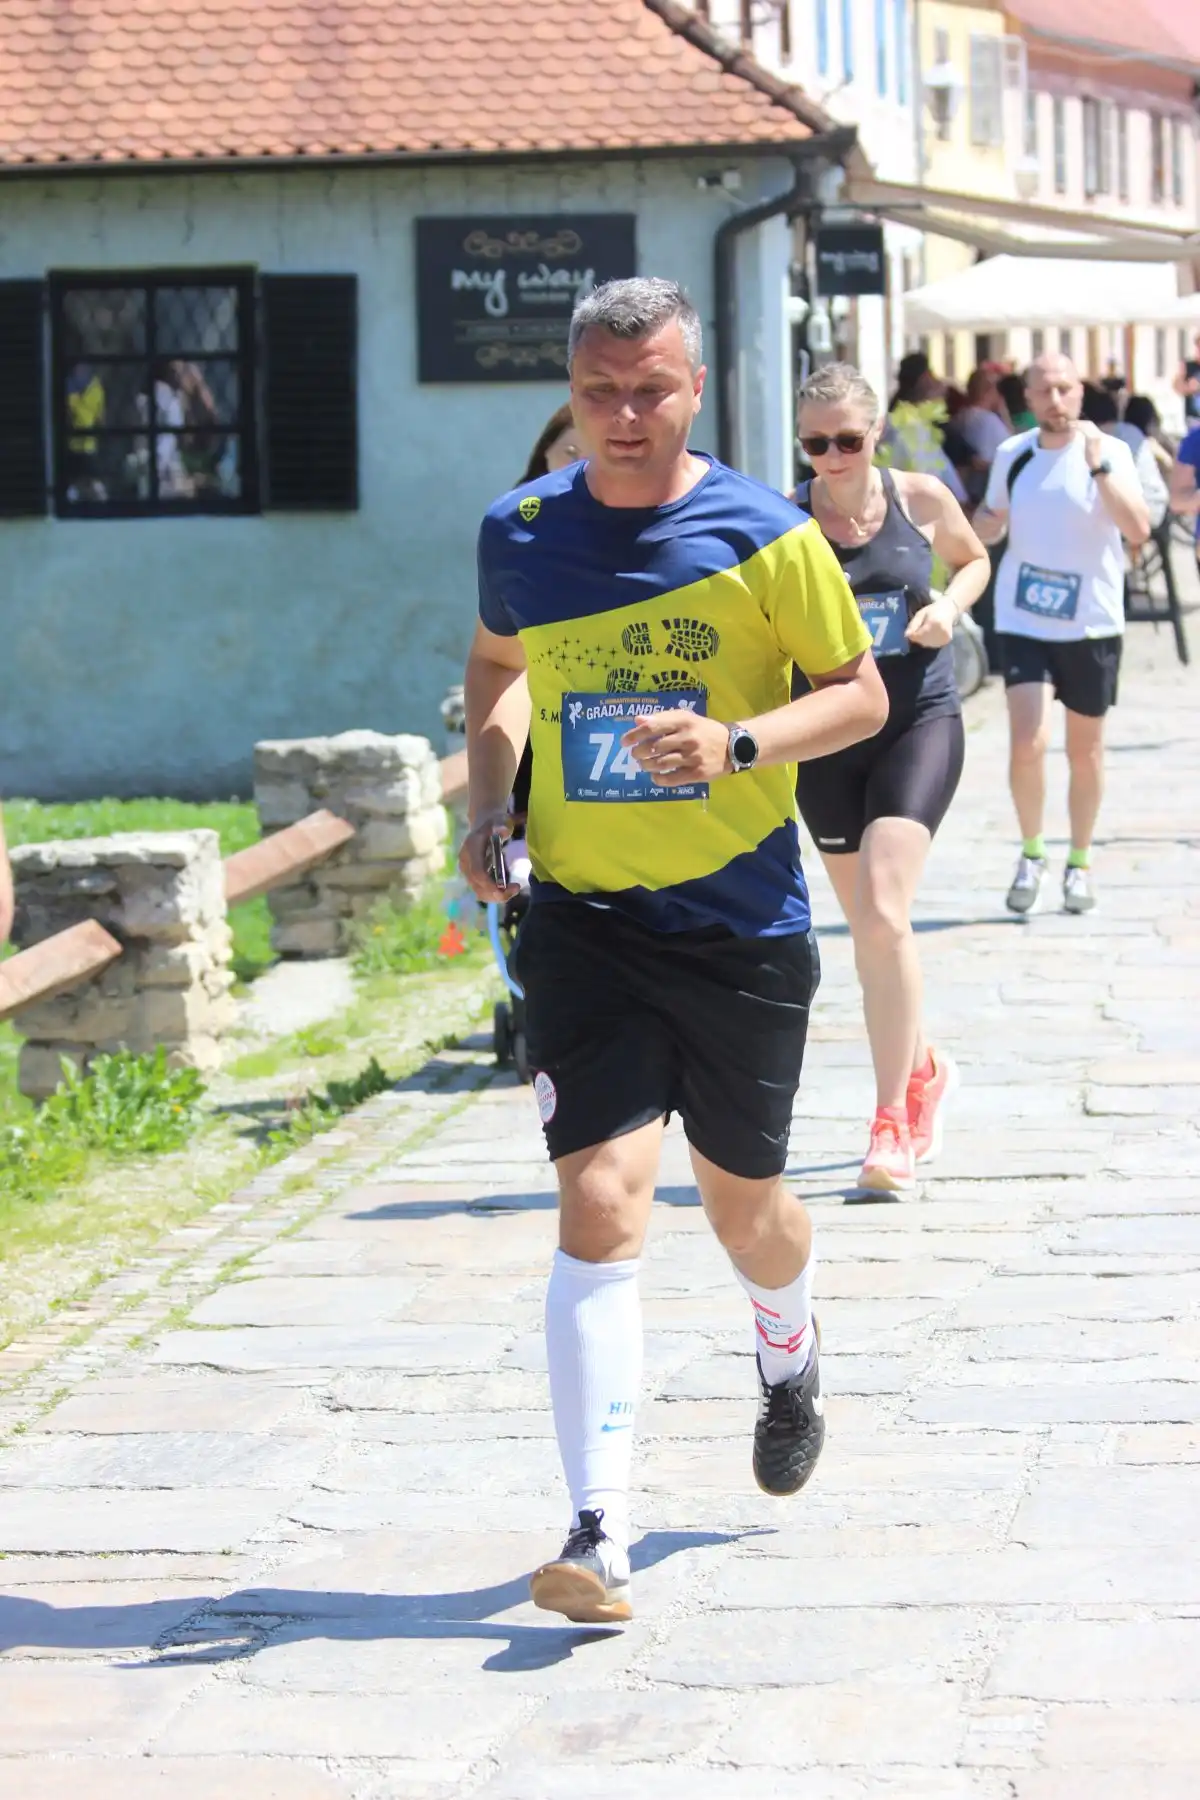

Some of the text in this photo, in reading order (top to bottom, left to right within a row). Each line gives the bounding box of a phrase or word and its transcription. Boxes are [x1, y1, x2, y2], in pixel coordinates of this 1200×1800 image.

[451, 262, 595, 317] my way
[1025, 583, 1069, 610] 657
[871, 616, 890, 647] 7
[586, 703, 623, 720] GRADA
[589, 733, 645, 781] 74
